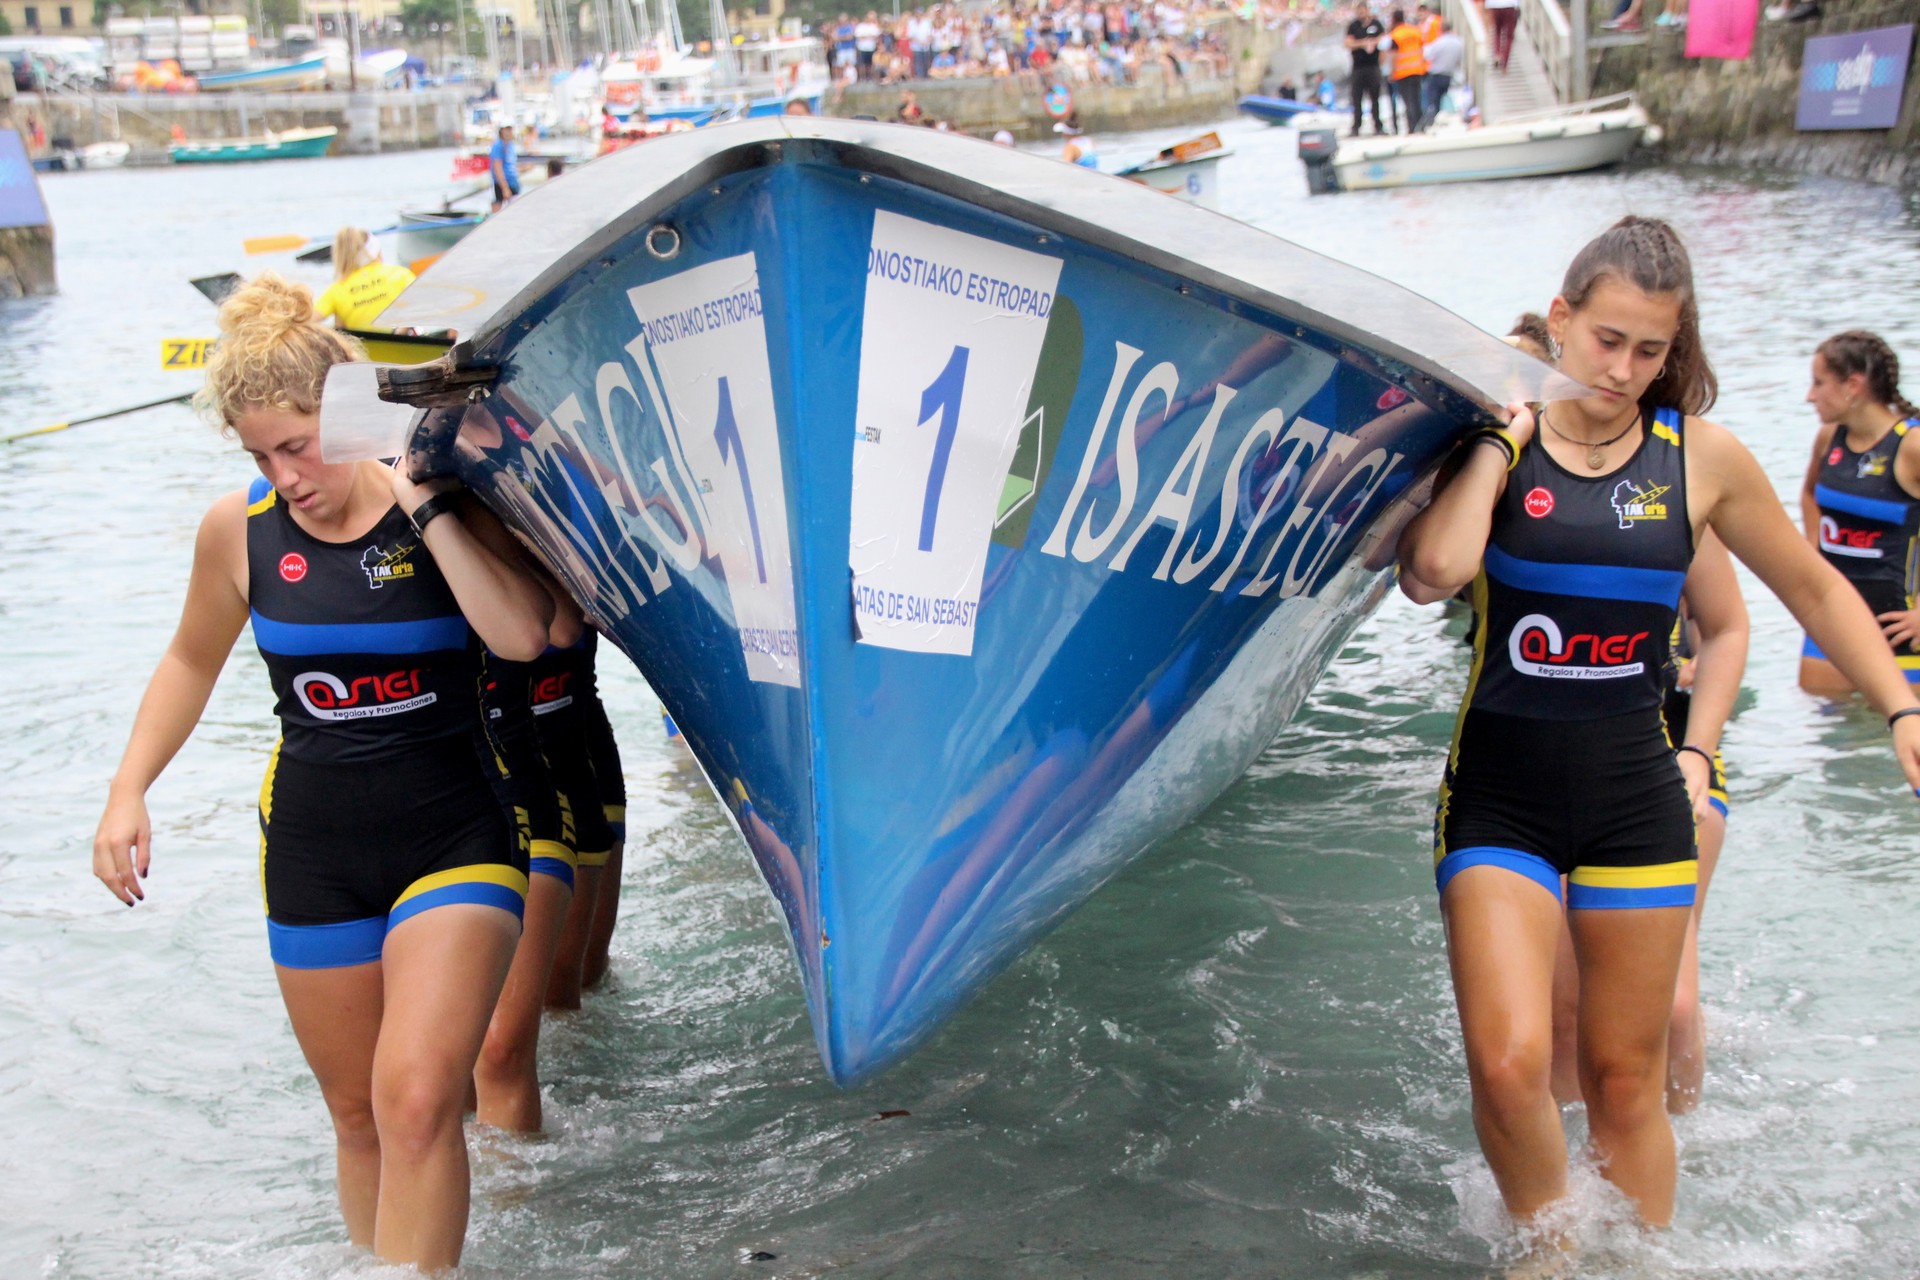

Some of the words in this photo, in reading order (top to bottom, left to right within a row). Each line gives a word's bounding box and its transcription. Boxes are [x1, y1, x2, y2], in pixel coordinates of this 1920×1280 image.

[966, 273, 1051, 318] ESTROPAD
[917, 345, 970, 552] 1
[713, 376, 767, 584] 1
[1040, 341, 1405, 599] ISASTEGI
[1623, 503, 1644, 516] TAK
[372, 565, 392, 577] TAK
[888, 592, 904, 620] DE
[907, 595, 930, 623] SAN
[933, 598, 976, 627] SEBAST
[1538, 667, 1573, 676] Regalos
[1584, 665, 1640, 676] Promociones
[333, 709, 367, 719] Regalos
[369, 708, 374, 717] y
[376, 695, 433, 714] Promociones
